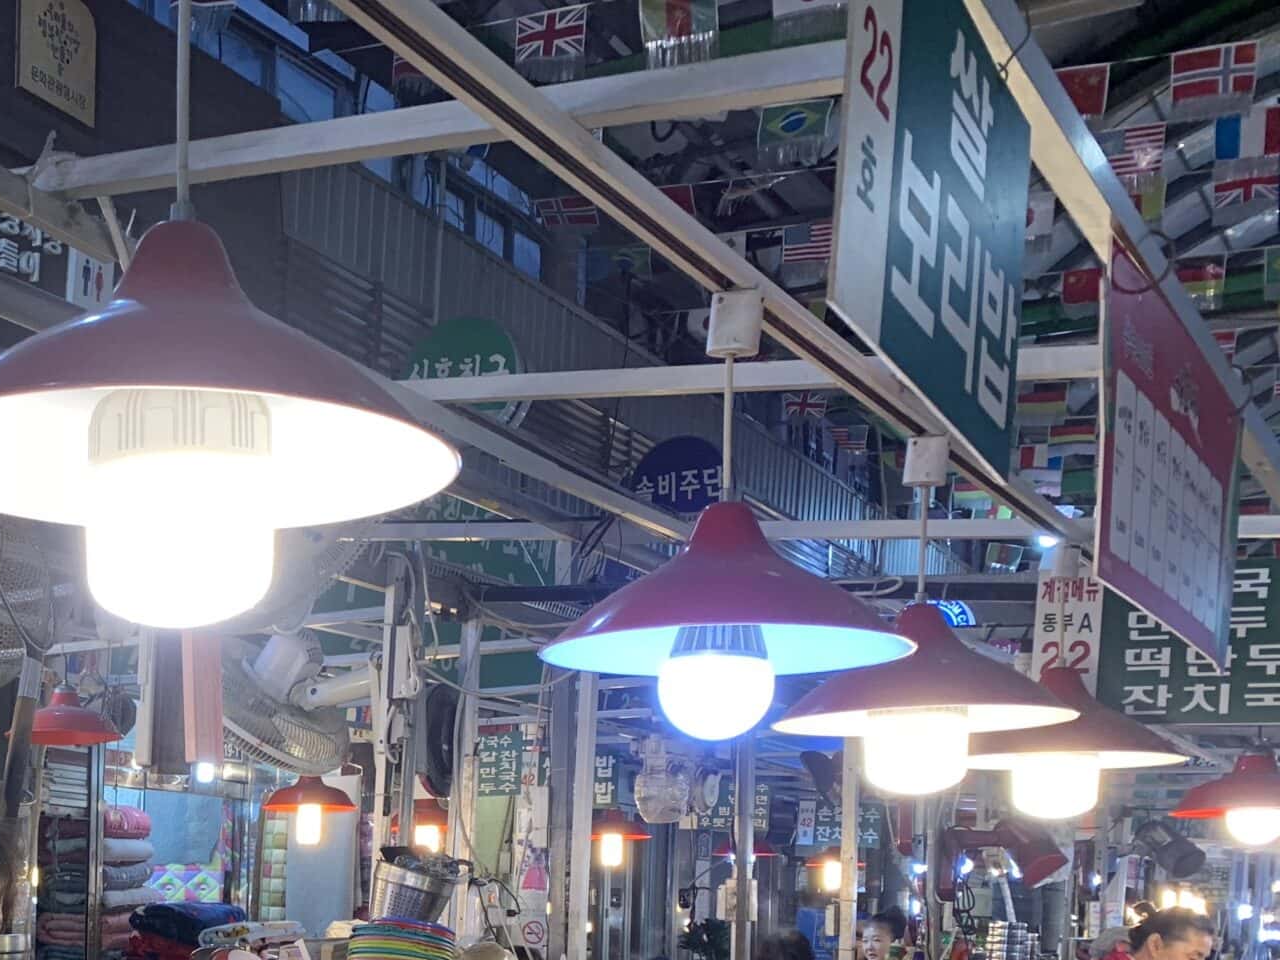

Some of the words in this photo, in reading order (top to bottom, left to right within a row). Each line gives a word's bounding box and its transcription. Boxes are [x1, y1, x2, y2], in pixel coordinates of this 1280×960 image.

[860, 4, 894, 124] 22
[891, 128, 1018, 432] 보리밥
[1040, 640, 1092, 676] 22
